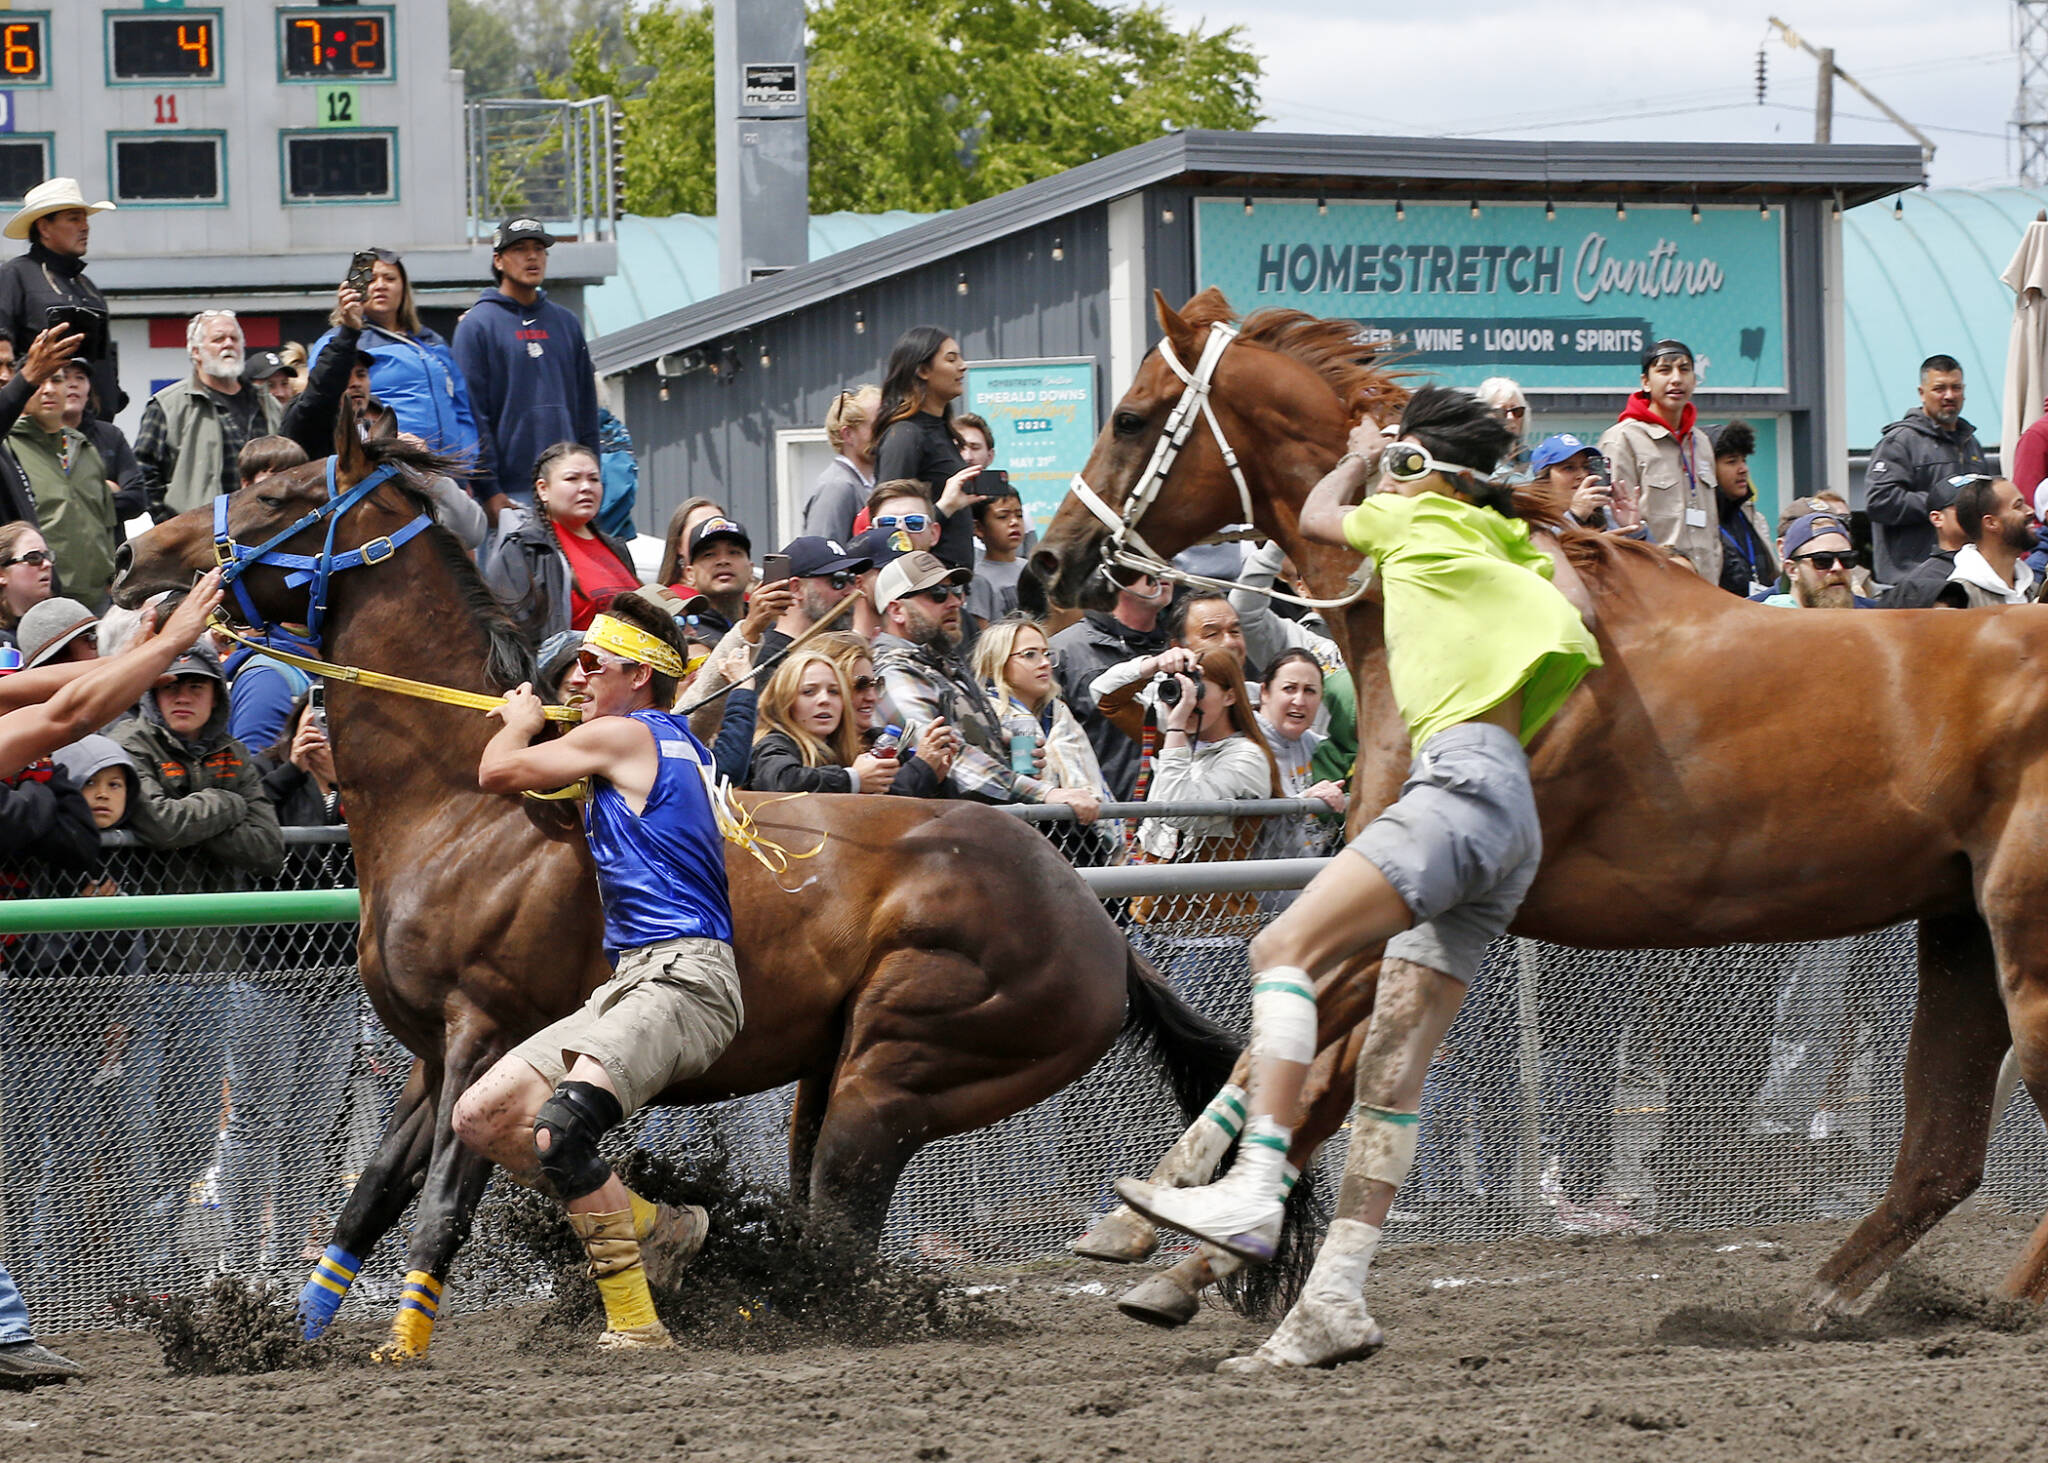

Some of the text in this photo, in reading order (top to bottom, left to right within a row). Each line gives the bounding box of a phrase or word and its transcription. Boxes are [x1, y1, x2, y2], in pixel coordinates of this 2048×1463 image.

[4, 24, 34, 74] 6
[177, 24, 208, 68] 4
[153, 94, 178, 124] 11
[327, 91, 352, 122] 12
[1257, 231, 1725, 303] HOMESTRETCH Cantina
[1413, 328, 1464, 351] WINE
[1484, 328, 1555, 351] LIQUOR
[1575, 329, 1643, 352] SPIRITS
[976, 388, 1087, 404] EMERALD DOWNS
[1017, 421, 1047, 431] 2024
